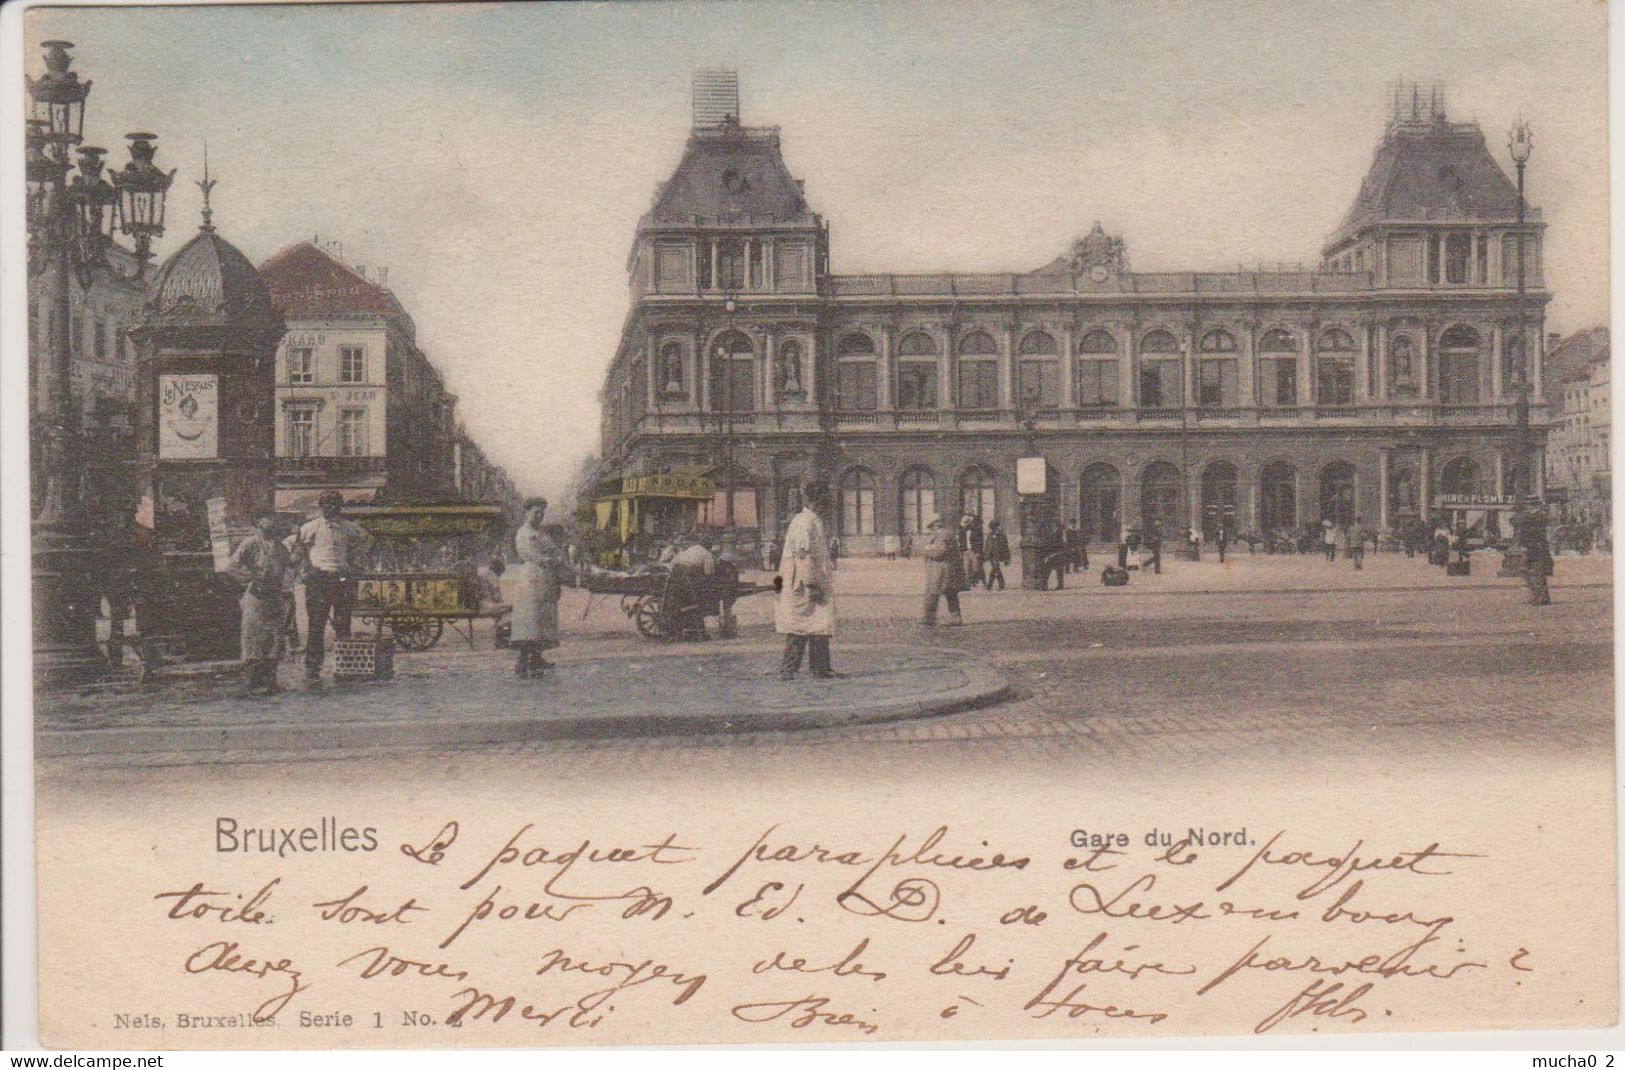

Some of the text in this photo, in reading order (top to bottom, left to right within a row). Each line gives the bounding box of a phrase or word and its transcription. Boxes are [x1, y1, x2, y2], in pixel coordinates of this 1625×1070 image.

[216, 816, 378, 857] Bruxelles
[1070, 827, 1257, 848] Gare du Nord.
[299, 1010, 354, 1027] Serie
[373, 1012, 384, 1029] 1
[401, 1010, 437, 1027] No.
